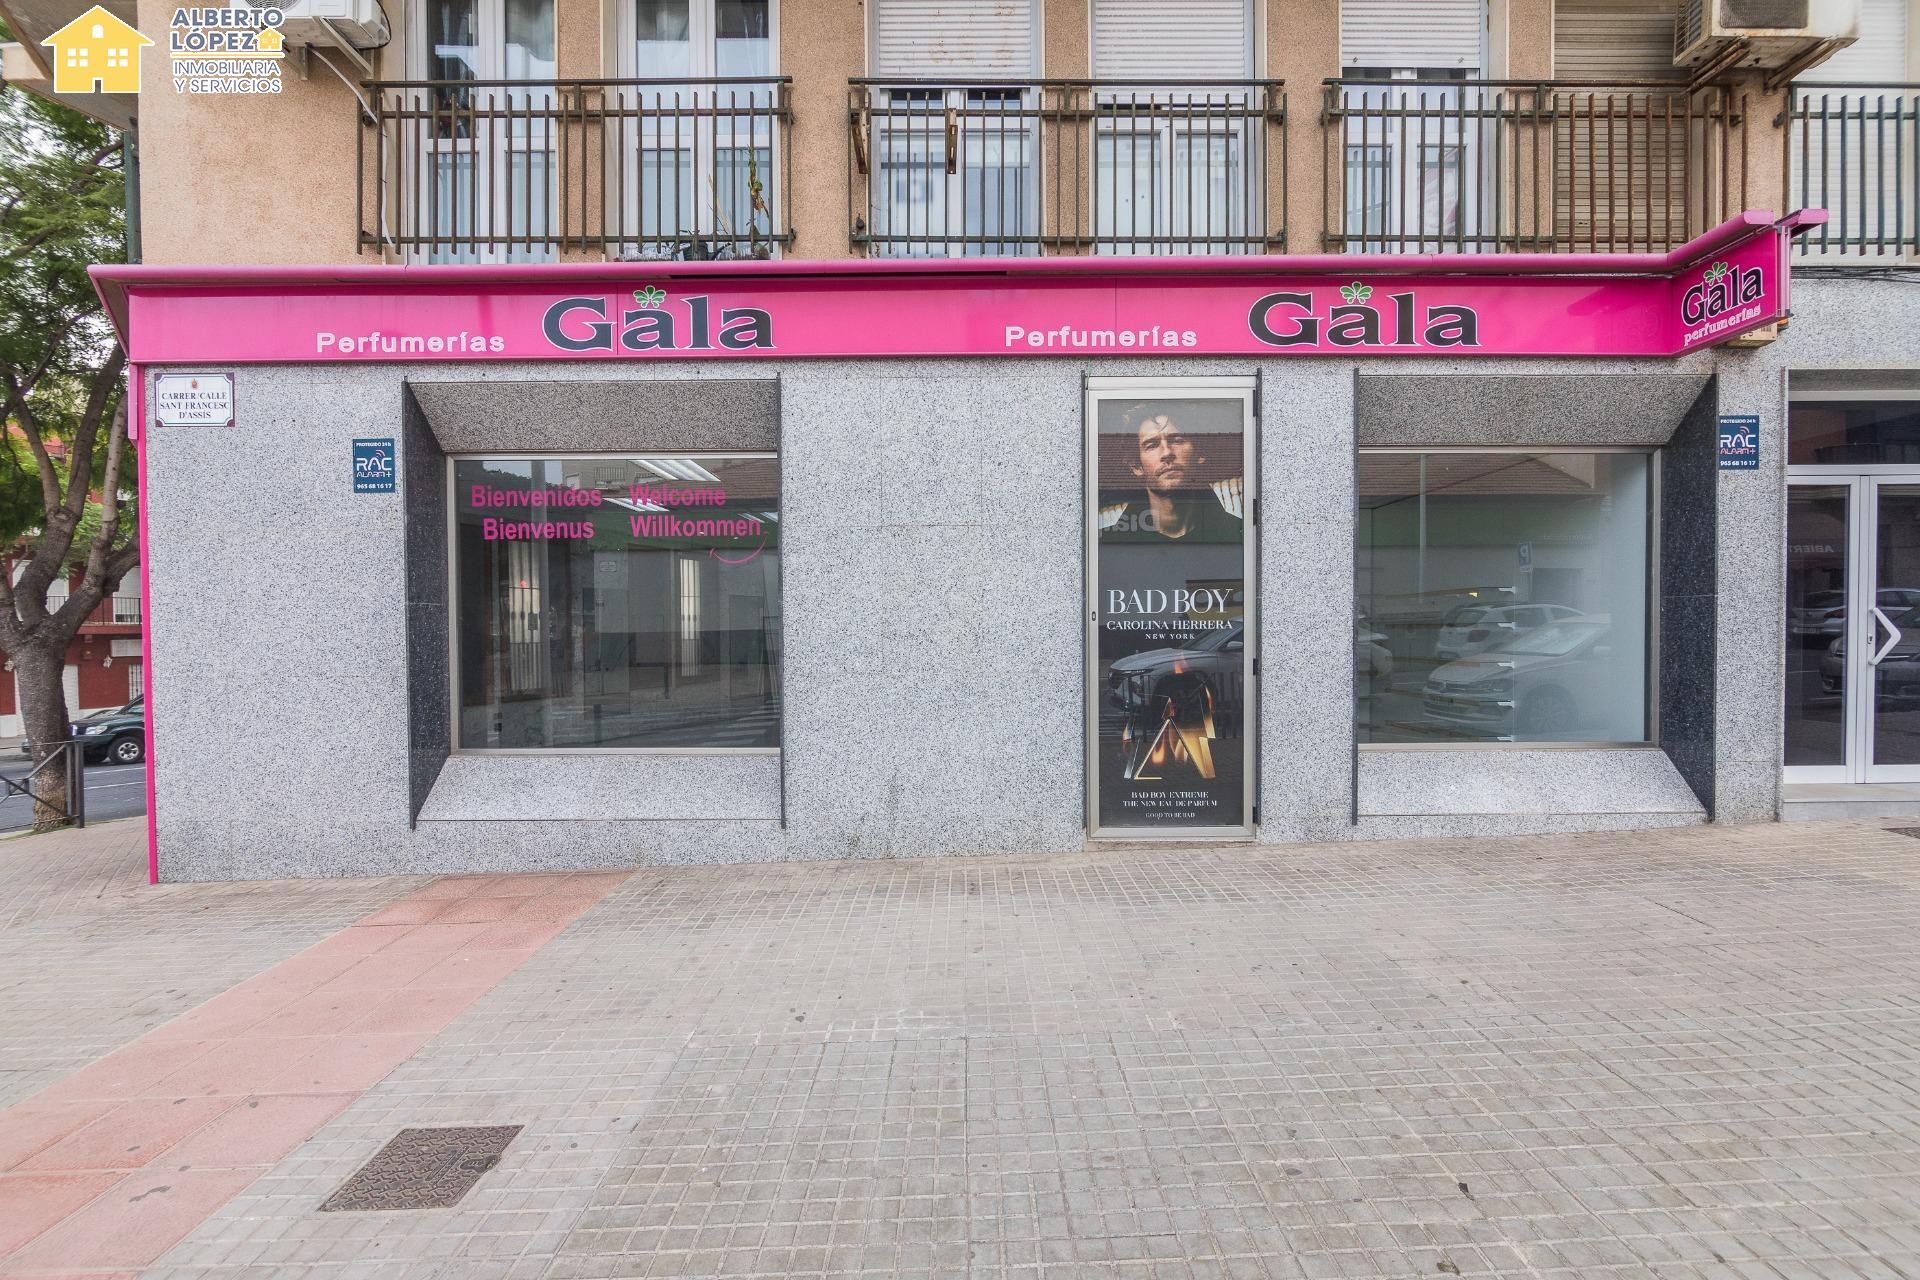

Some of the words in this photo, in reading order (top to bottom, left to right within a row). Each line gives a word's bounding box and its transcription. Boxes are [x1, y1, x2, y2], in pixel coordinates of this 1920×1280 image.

[1681, 264, 1765, 327] Gala
[316, 331, 505, 353] Perfumerías
[542, 294, 777, 352] Gala
[1004, 326, 1198, 348] Perfumerías
[1247, 291, 1482, 348] Gala
[185, 401, 229, 409] FRANCESC
[1720, 434, 1756, 448] RAC
[356, 457, 392, 471] RAC
[471, 485, 602, 507] Bienvenidos
[629, 484, 727, 506] Welcome
[483, 518, 595, 540] Bienvenus
[629, 515, 761, 538] Willkommen
[1106, 589, 1168, 614] BAD
[1171, 588, 1234, 614] BOY
[1106, 620, 1169, 630] CAROLINA
[1172, 620, 1233, 630] HERRERA
[1131, 791, 1149, 799] BAD
[1150, 791, 1166, 799] BOY
[1169, 791, 1209, 799] EXTREME
